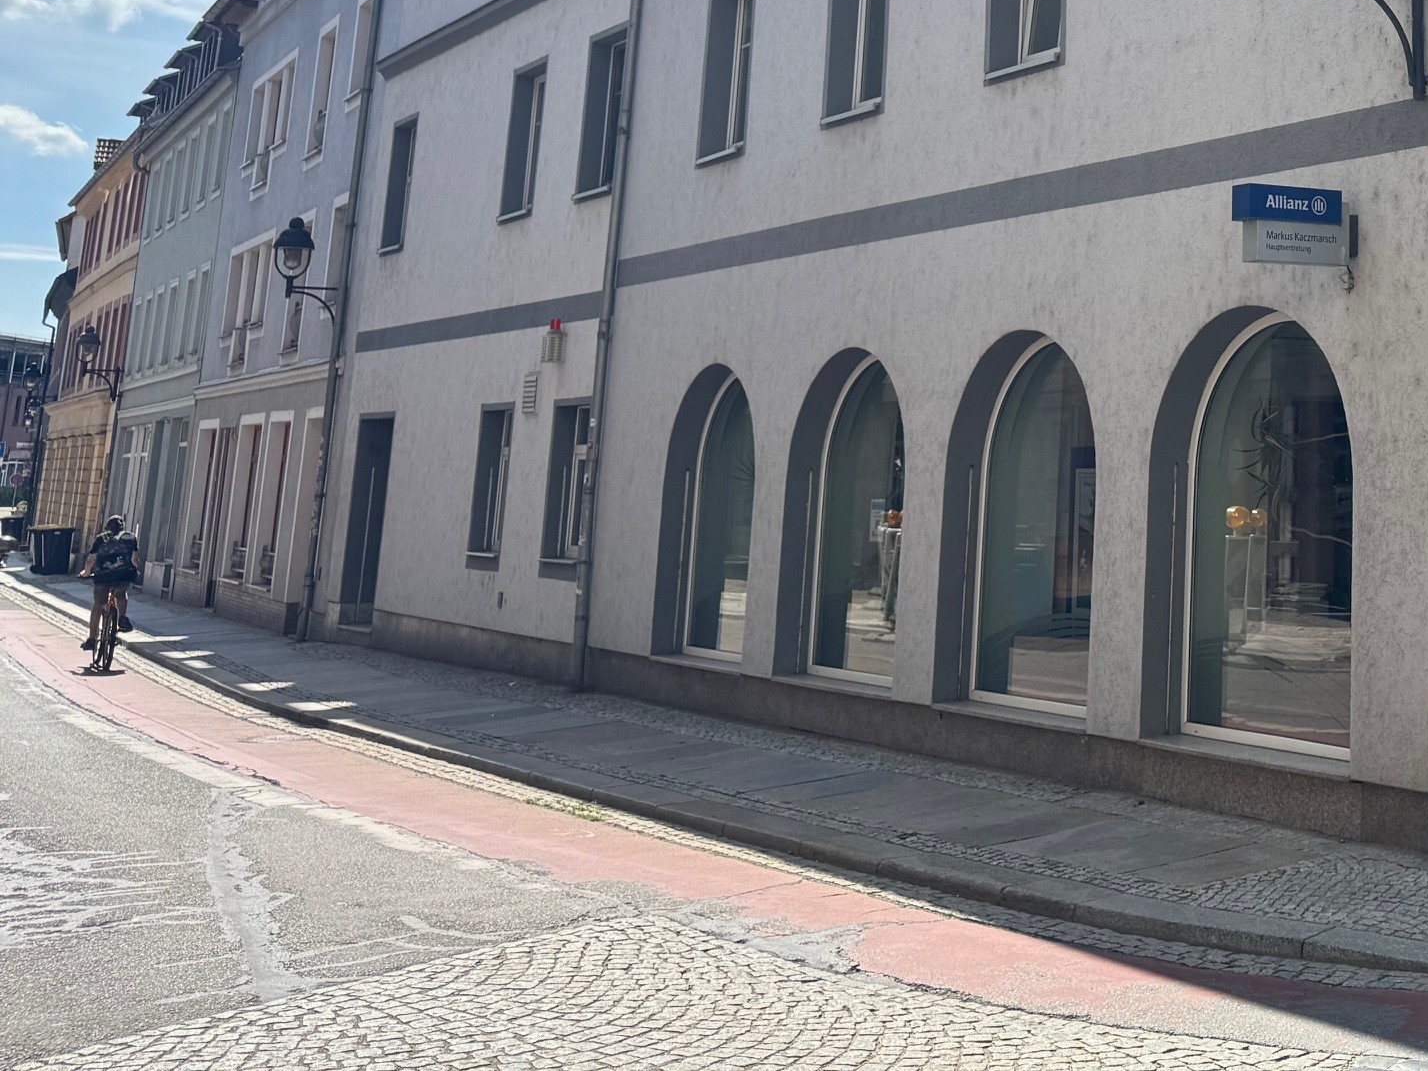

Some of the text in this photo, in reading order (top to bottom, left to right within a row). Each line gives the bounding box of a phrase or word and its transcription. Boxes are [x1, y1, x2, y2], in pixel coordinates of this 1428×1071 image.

[1266, 194, 1309, 211] Allianz
[1266, 230, 1337, 243] Markus Kaczmarsch
[1266, 243, 1312, 254] Hauptvertretung
